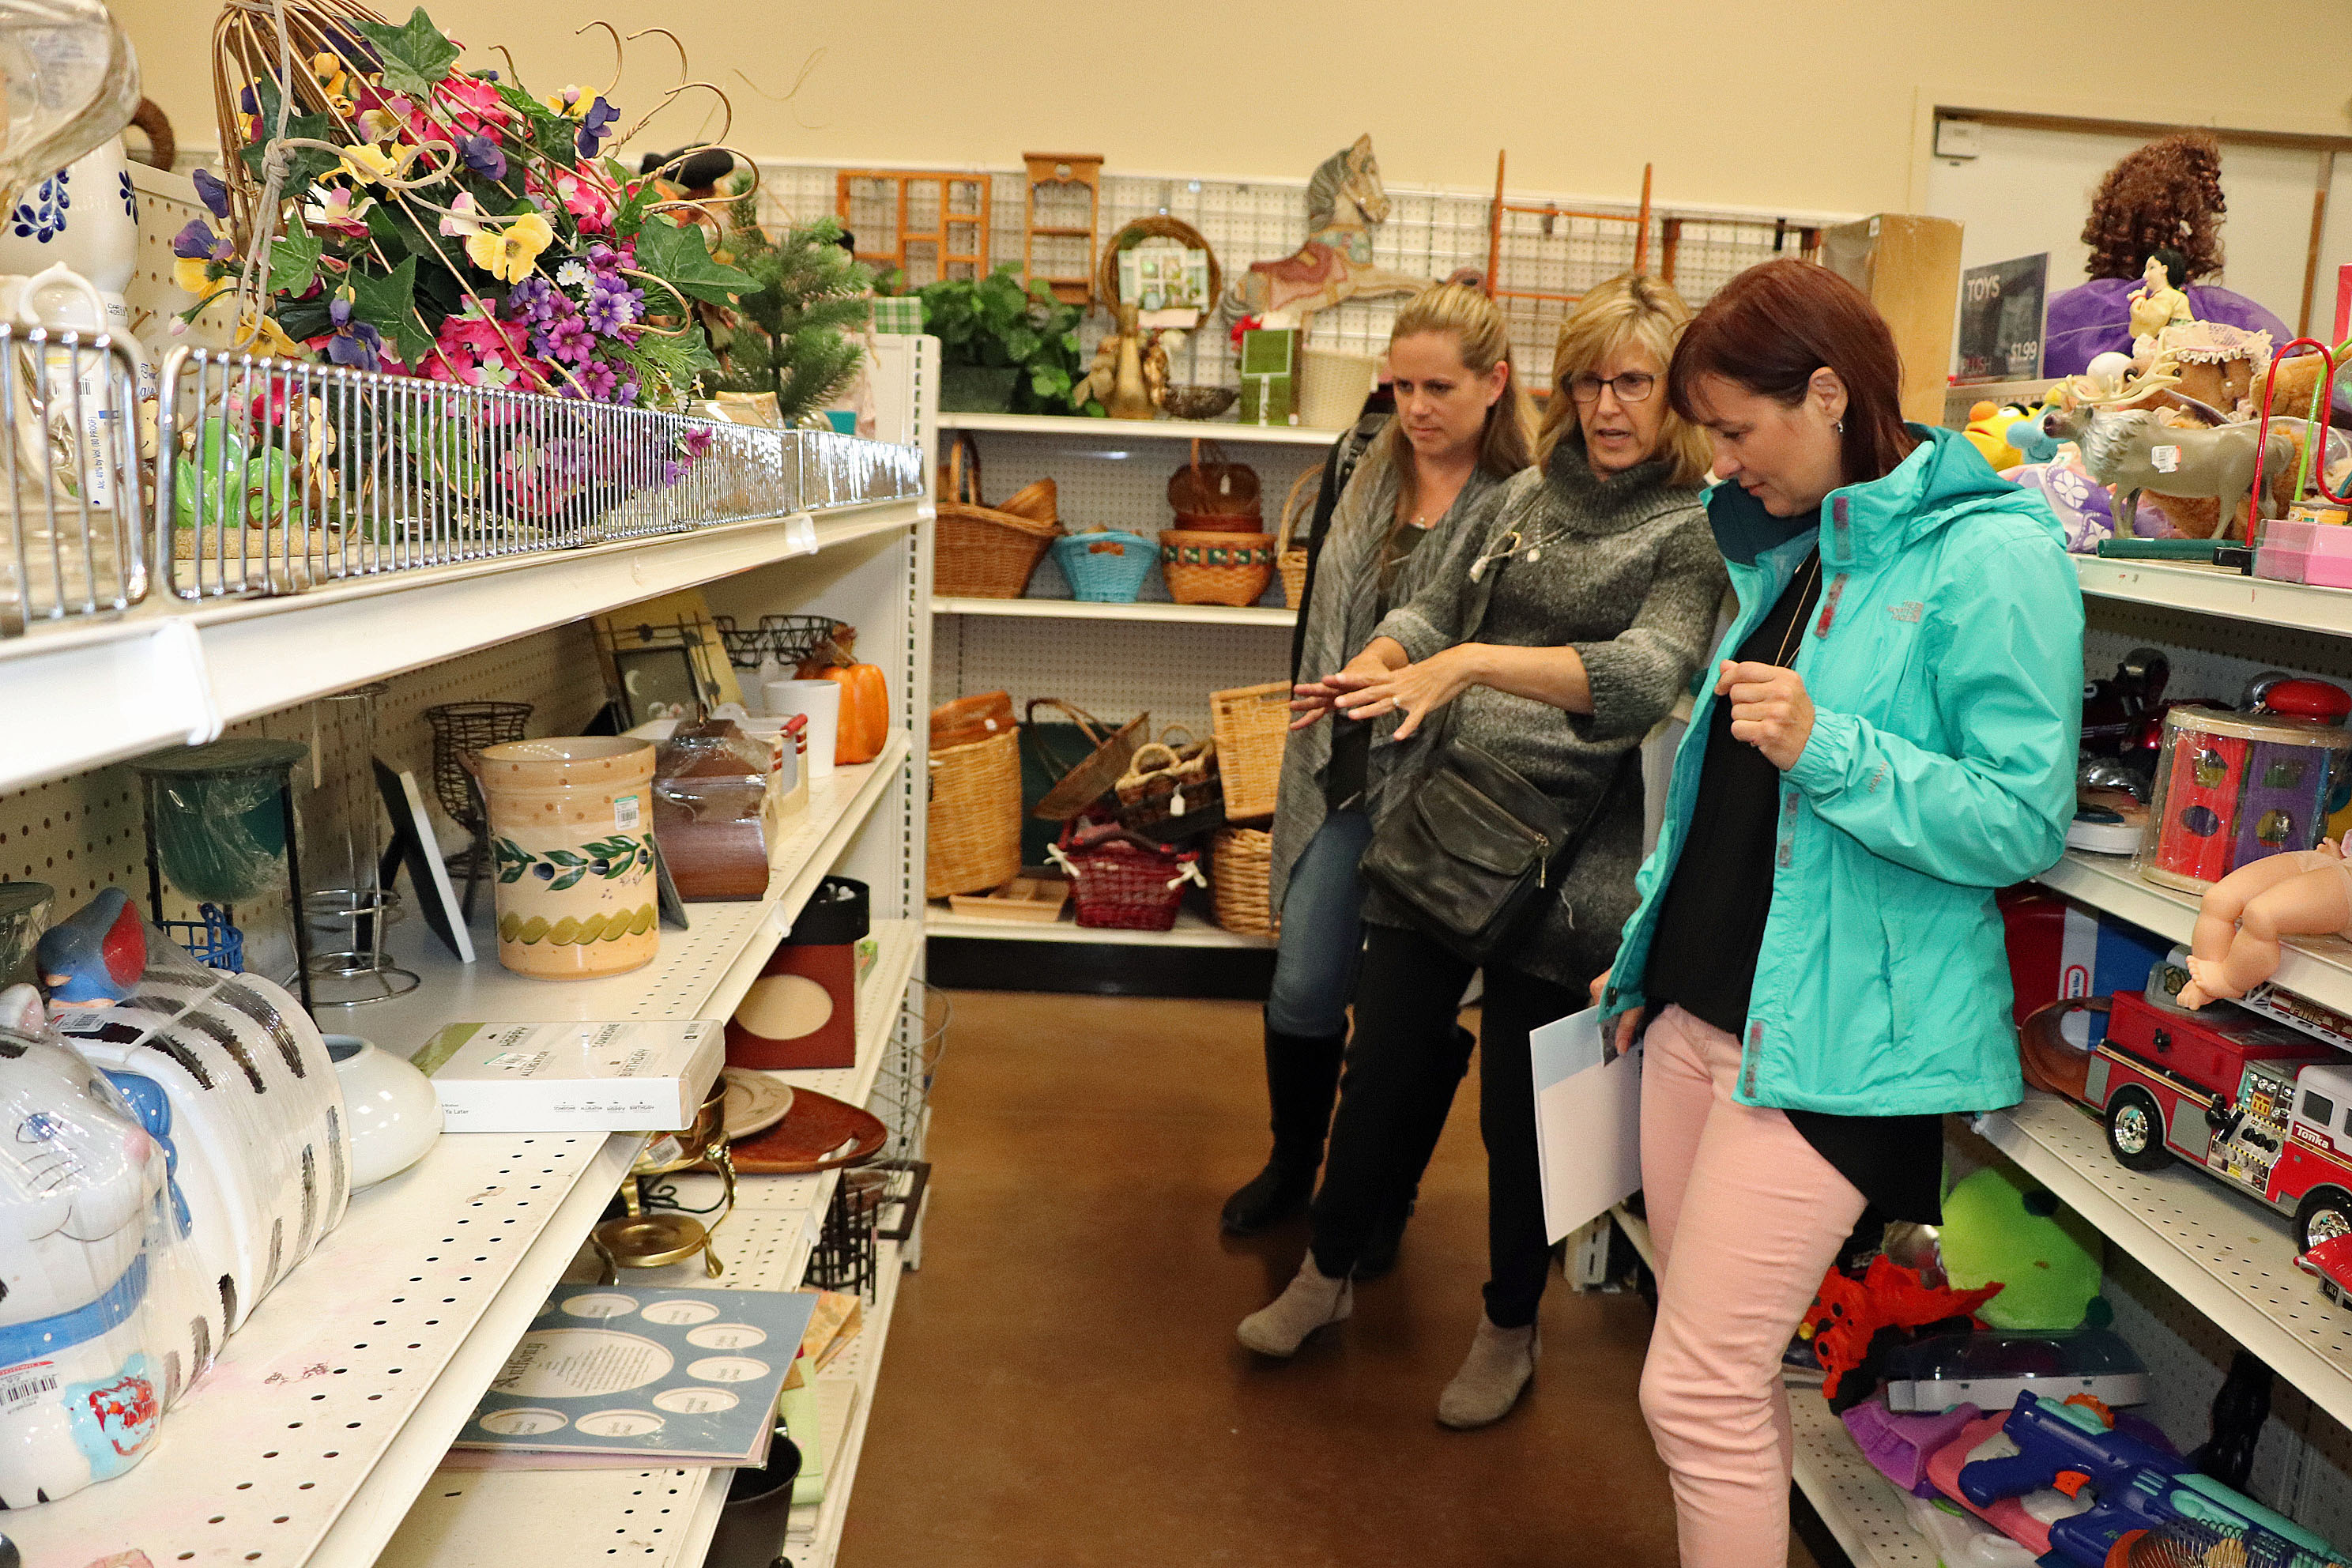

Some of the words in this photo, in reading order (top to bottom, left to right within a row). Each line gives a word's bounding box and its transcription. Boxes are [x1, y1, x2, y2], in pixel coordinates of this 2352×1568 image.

[1967, 274, 2000, 302] TOYS
[88, 416, 98, 438] PROOF)
[91, 438, 101, 447] (80
[95, 466, 104, 478] 40%
[2290, 998, 2325, 1025] FIRE
[499, 1027, 529, 1046] HAPPY
[592, 1023, 620, 1048] SOMEONE
[520, 1050, 550, 1077] ALLIGATOR
[618, 1049, 650, 1077] BIRTHDAY
[2295, 1124, 2329, 1149] Tonka
